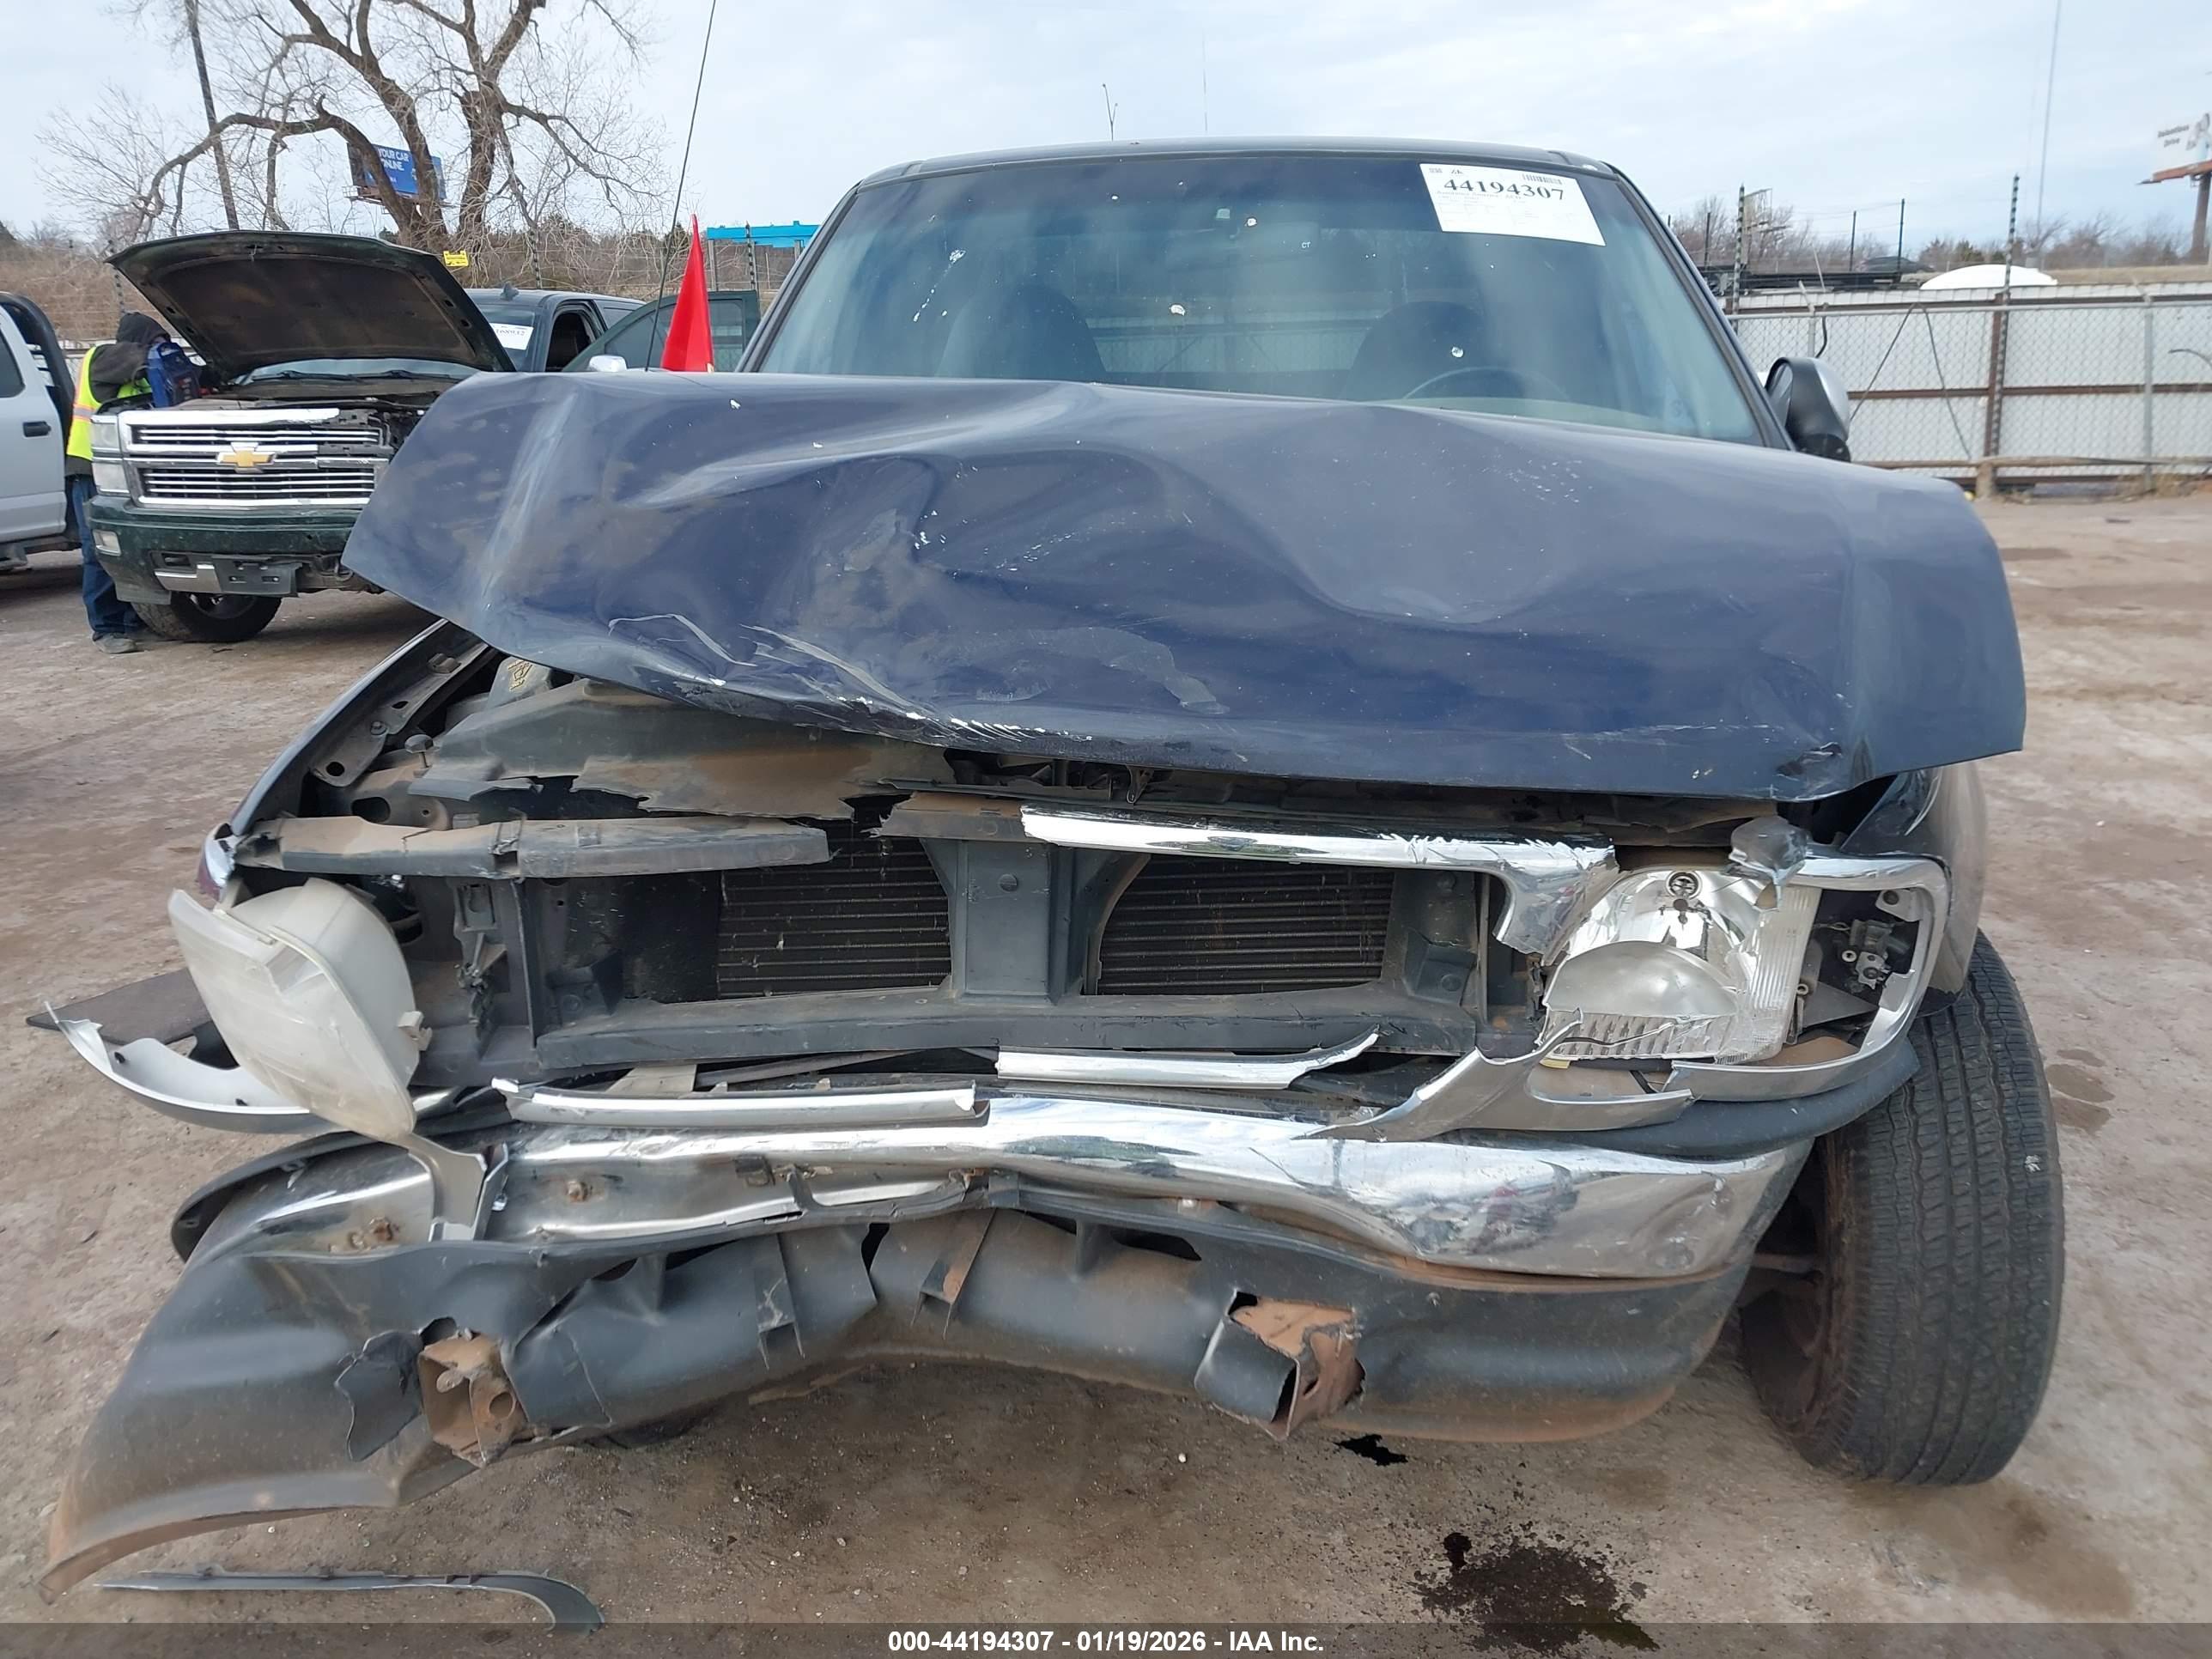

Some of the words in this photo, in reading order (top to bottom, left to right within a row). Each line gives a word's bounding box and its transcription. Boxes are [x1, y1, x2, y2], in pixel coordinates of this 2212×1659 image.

[378, 148, 396, 160] YOUR
[396, 151, 409, 162] CAR
[1443, 179, 1564, 200] 44194307
